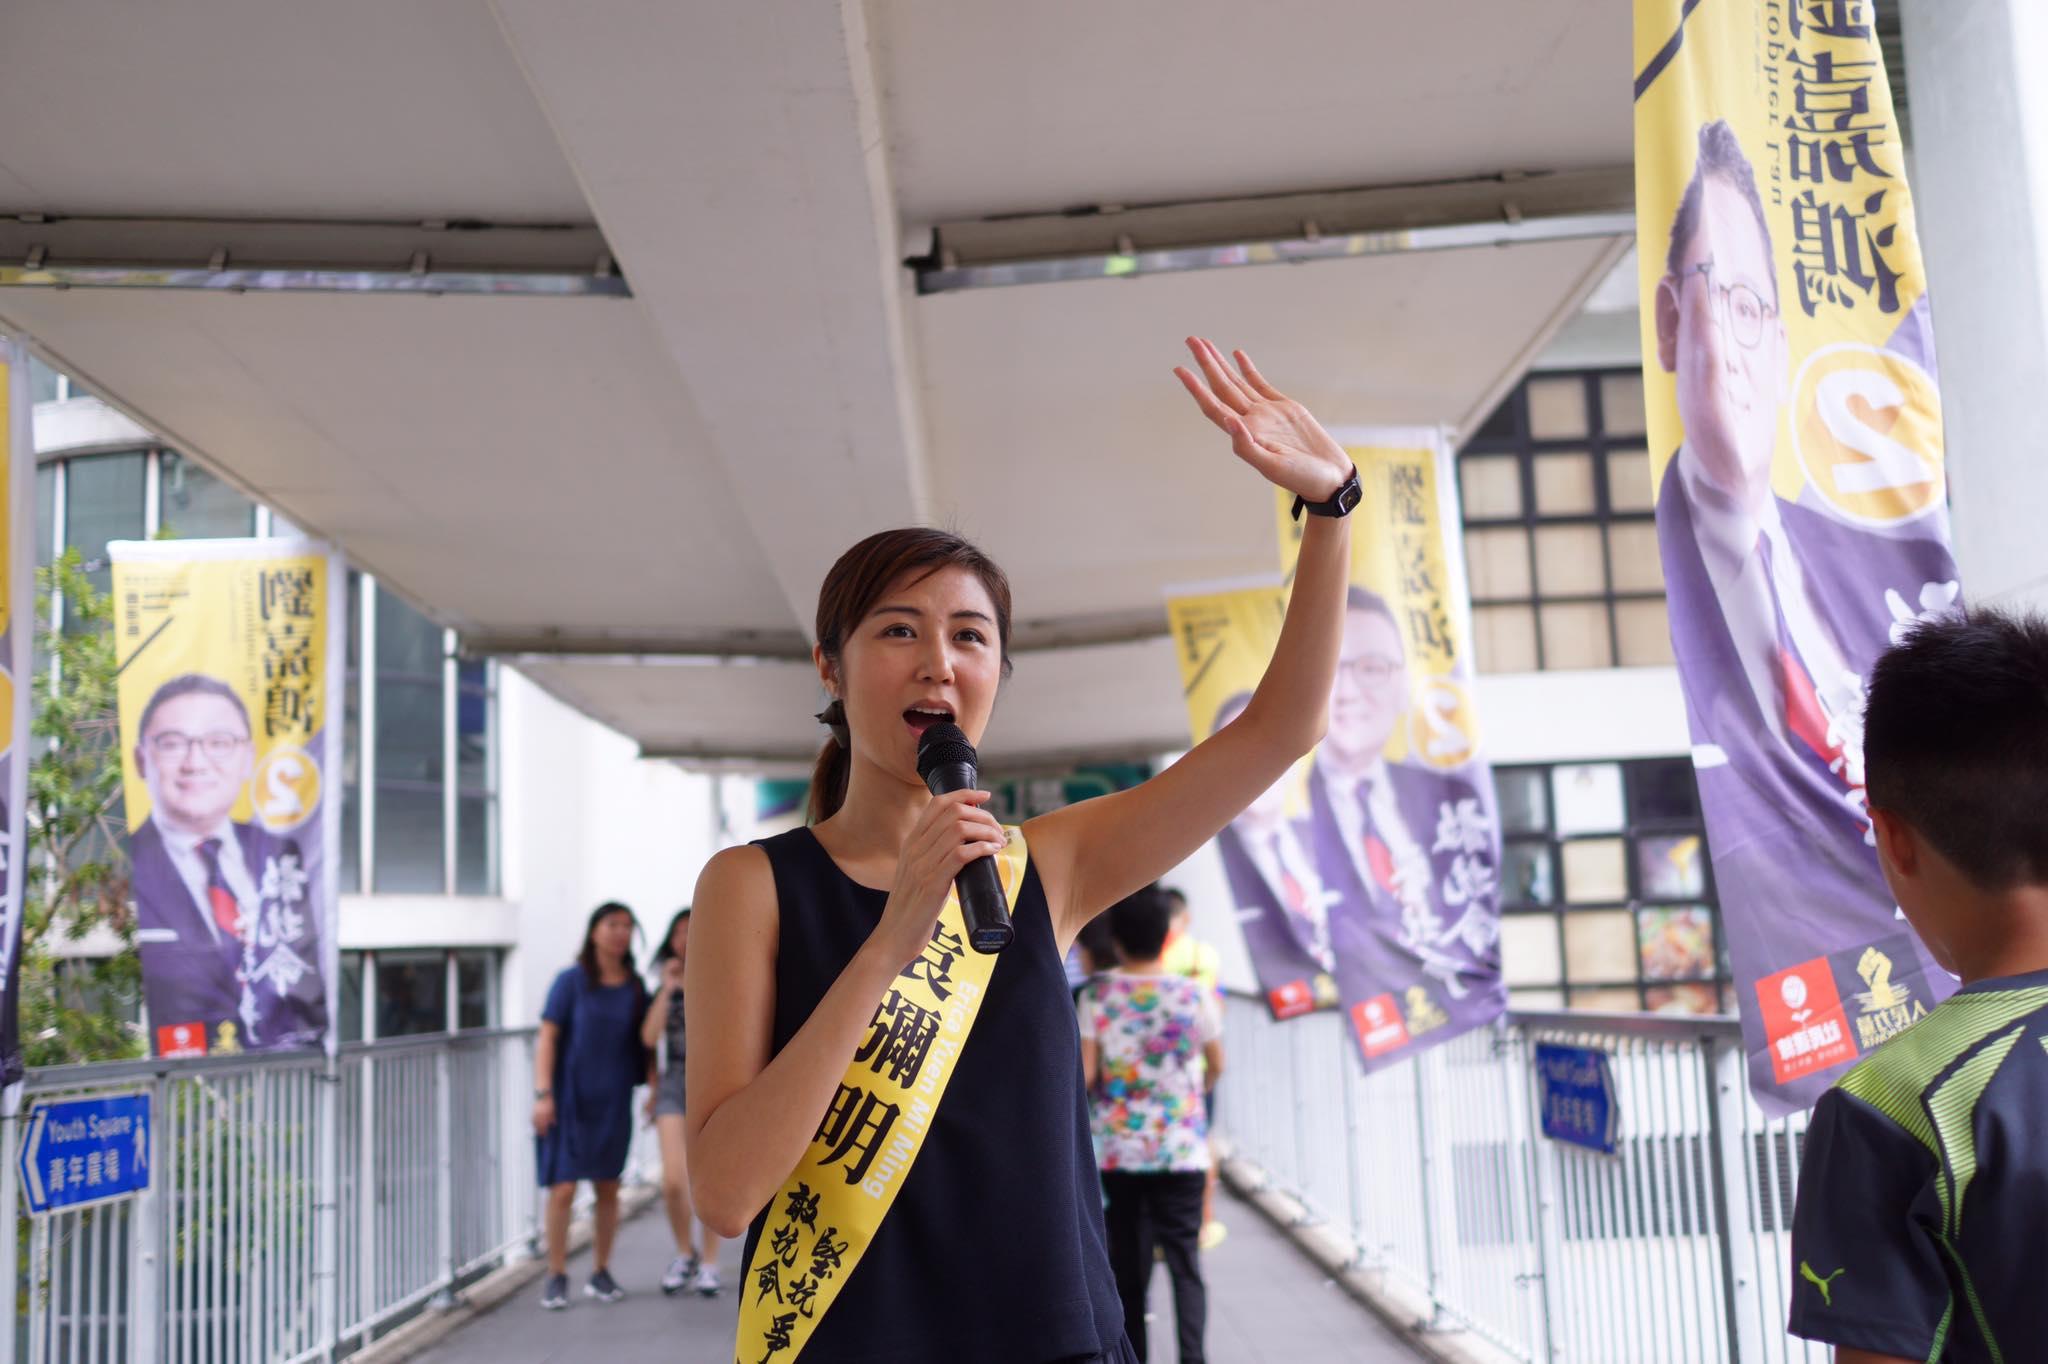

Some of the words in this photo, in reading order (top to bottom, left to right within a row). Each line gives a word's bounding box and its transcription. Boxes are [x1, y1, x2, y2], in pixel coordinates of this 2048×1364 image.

[946, 979, 980, 1034] Erica
[918, 1035, 960, 1096] Yuen
[47, 1116, 87, 1145] Youth
[88, 1112, 132, 1142] Square
[903, 1102, 931, 1135] Mi
[48, 1147, 121, 1194] 青年廣場
[862, 1132, 914, 1200] Ming
